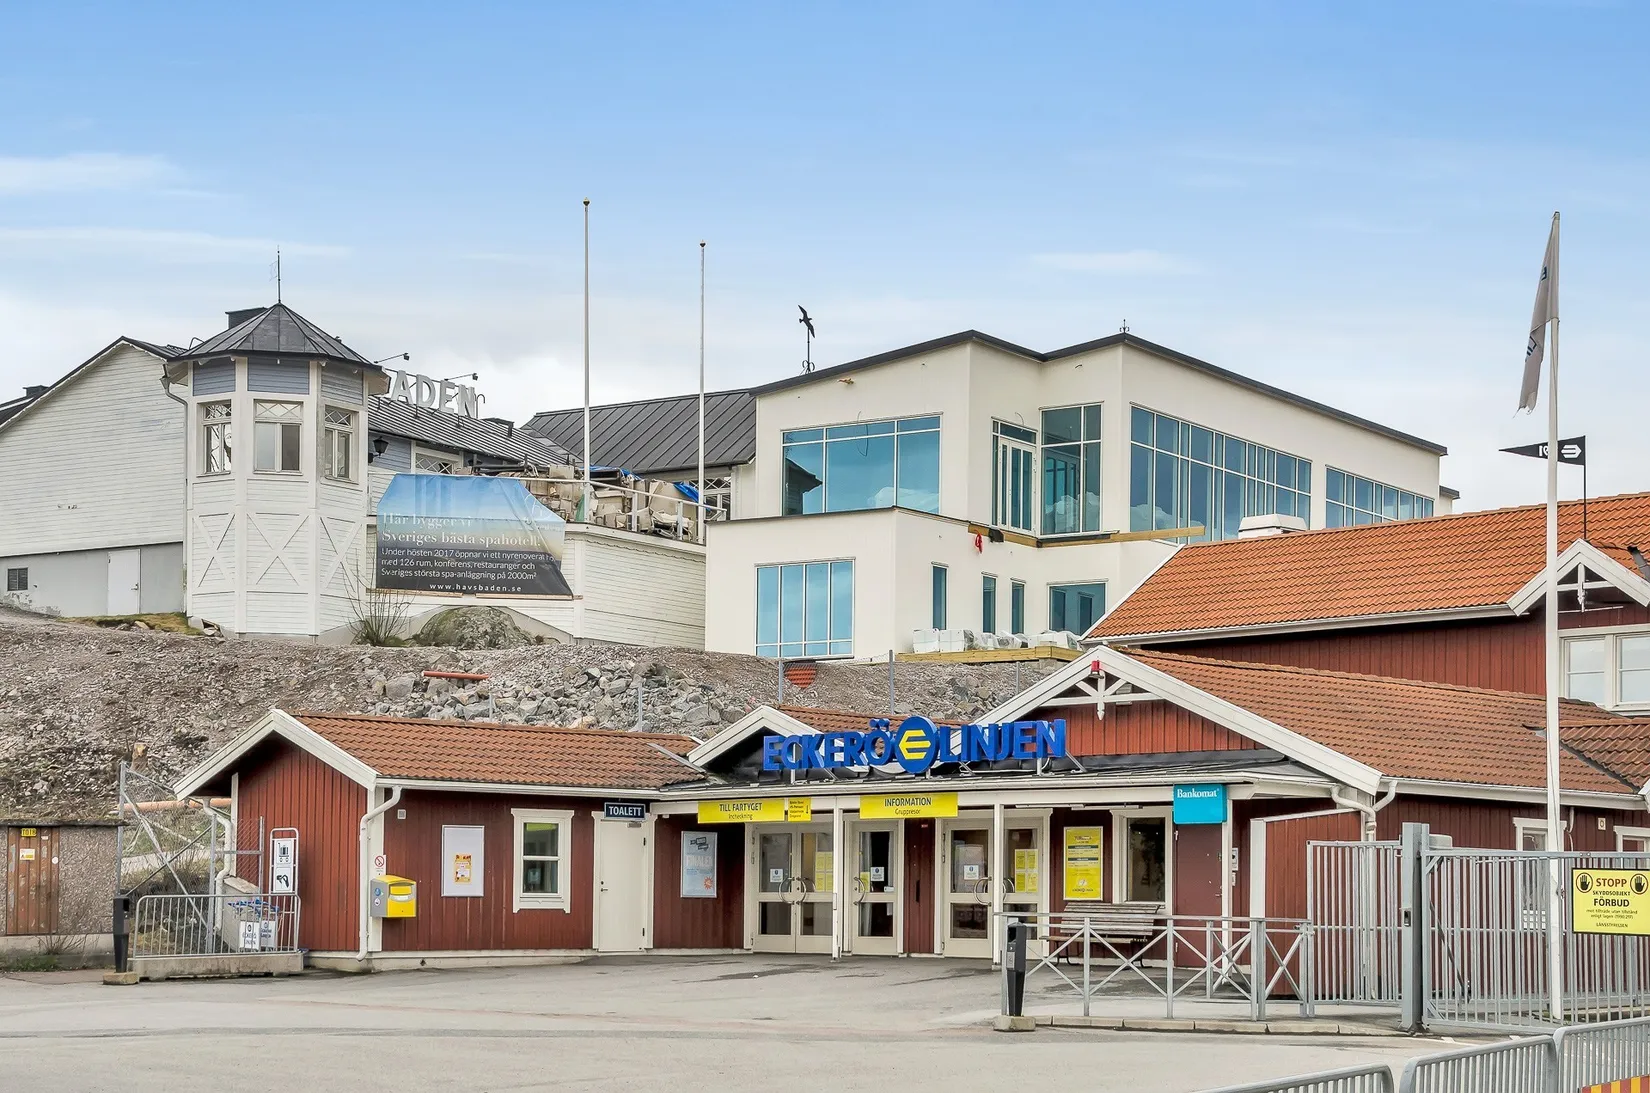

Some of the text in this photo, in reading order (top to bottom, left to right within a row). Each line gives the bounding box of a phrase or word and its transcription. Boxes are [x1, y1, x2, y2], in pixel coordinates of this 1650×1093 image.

[382, 512, 409, 526] Här
[412, 515, 459, 529] bygger
[381, 530, 437, 545] Sveriges
[441, 531, 475, 544] bästa
[381, 547, 406, 556] Under
[407, 548, 433, 557] hösten
[434, 549, 454, 557] 2017
[455, 550, 481, 560] öppnar
[482, 550, 489, 558] vi
[490, 551, 501, 559] ett
[400, 558, 415, 567] 126
[473, 561, 521, 570] restauranger
[521, 562, 536, 570] och
[381, 567, 413, 577] Sveriges
[414, 568, 440, 577] största
[441, 569, 496, 580] spa-anläggning
[496, 571, 507, 580] på
[429, 583, 522, 592] www.havsbaden.se
[763, 718, 1067, 771] ECKERÖ LINJEN
[1177, 787, 1218, 798] Bankomat
[719, 802, 763, 812] TILL FARTYGET
[885, 797, 932, 807] INFORMATION
[608, 806, 642, 816] TOALETT
[1596, 877, 1627, 888] STOPP
[1593, 896, 1630, 907] FÖRBUD
